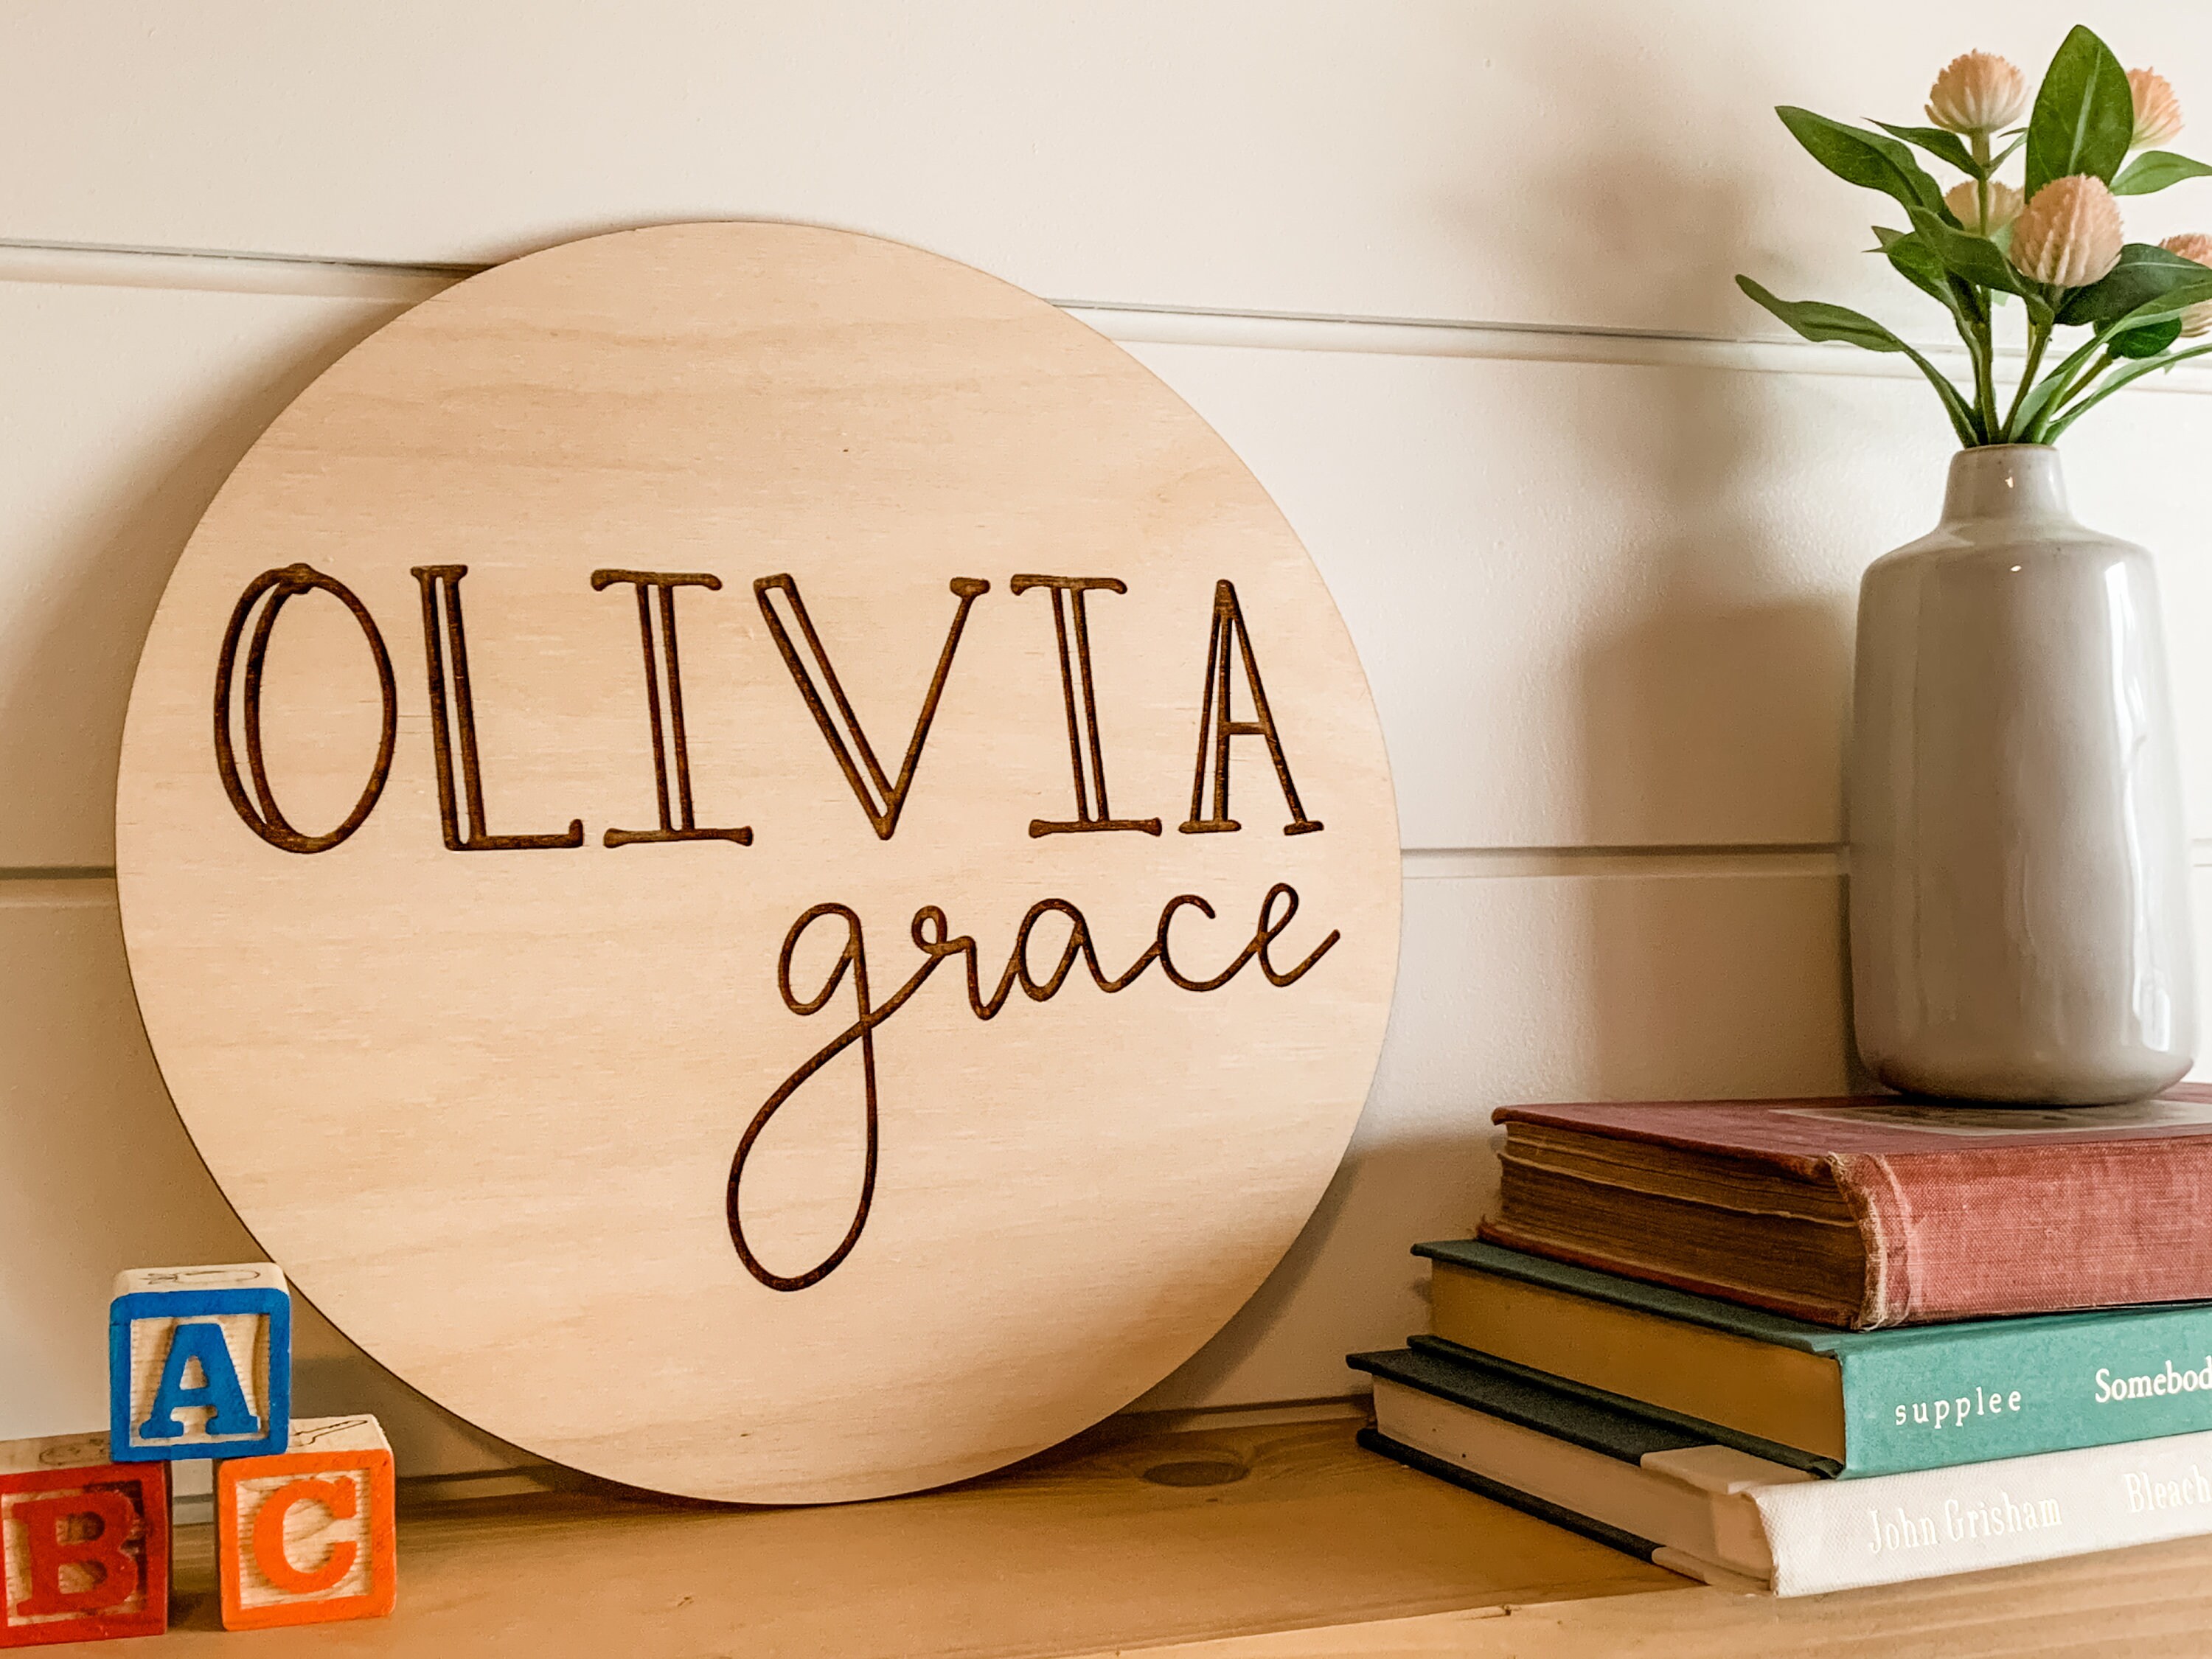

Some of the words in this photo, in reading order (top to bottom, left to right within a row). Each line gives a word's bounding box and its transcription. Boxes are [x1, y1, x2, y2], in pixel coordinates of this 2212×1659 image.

[214, 563, 1324, 853] OLIVIA
[727, 883, 1339, 1290] grace
[139, 1324, 260, 1439] A
[1894, 1387, 2022, 1429] supplee
[2095, 1355, 2212, 1403] Somebod
[13, 1489, 139, 1615] B
[253, 1477, 357, 1593] C
[1868, 1508, 1937, 1554] John
[1944, 1492, 2063, 1542] Grisham
[2124, 1464, 2212, 1513] Bleach
